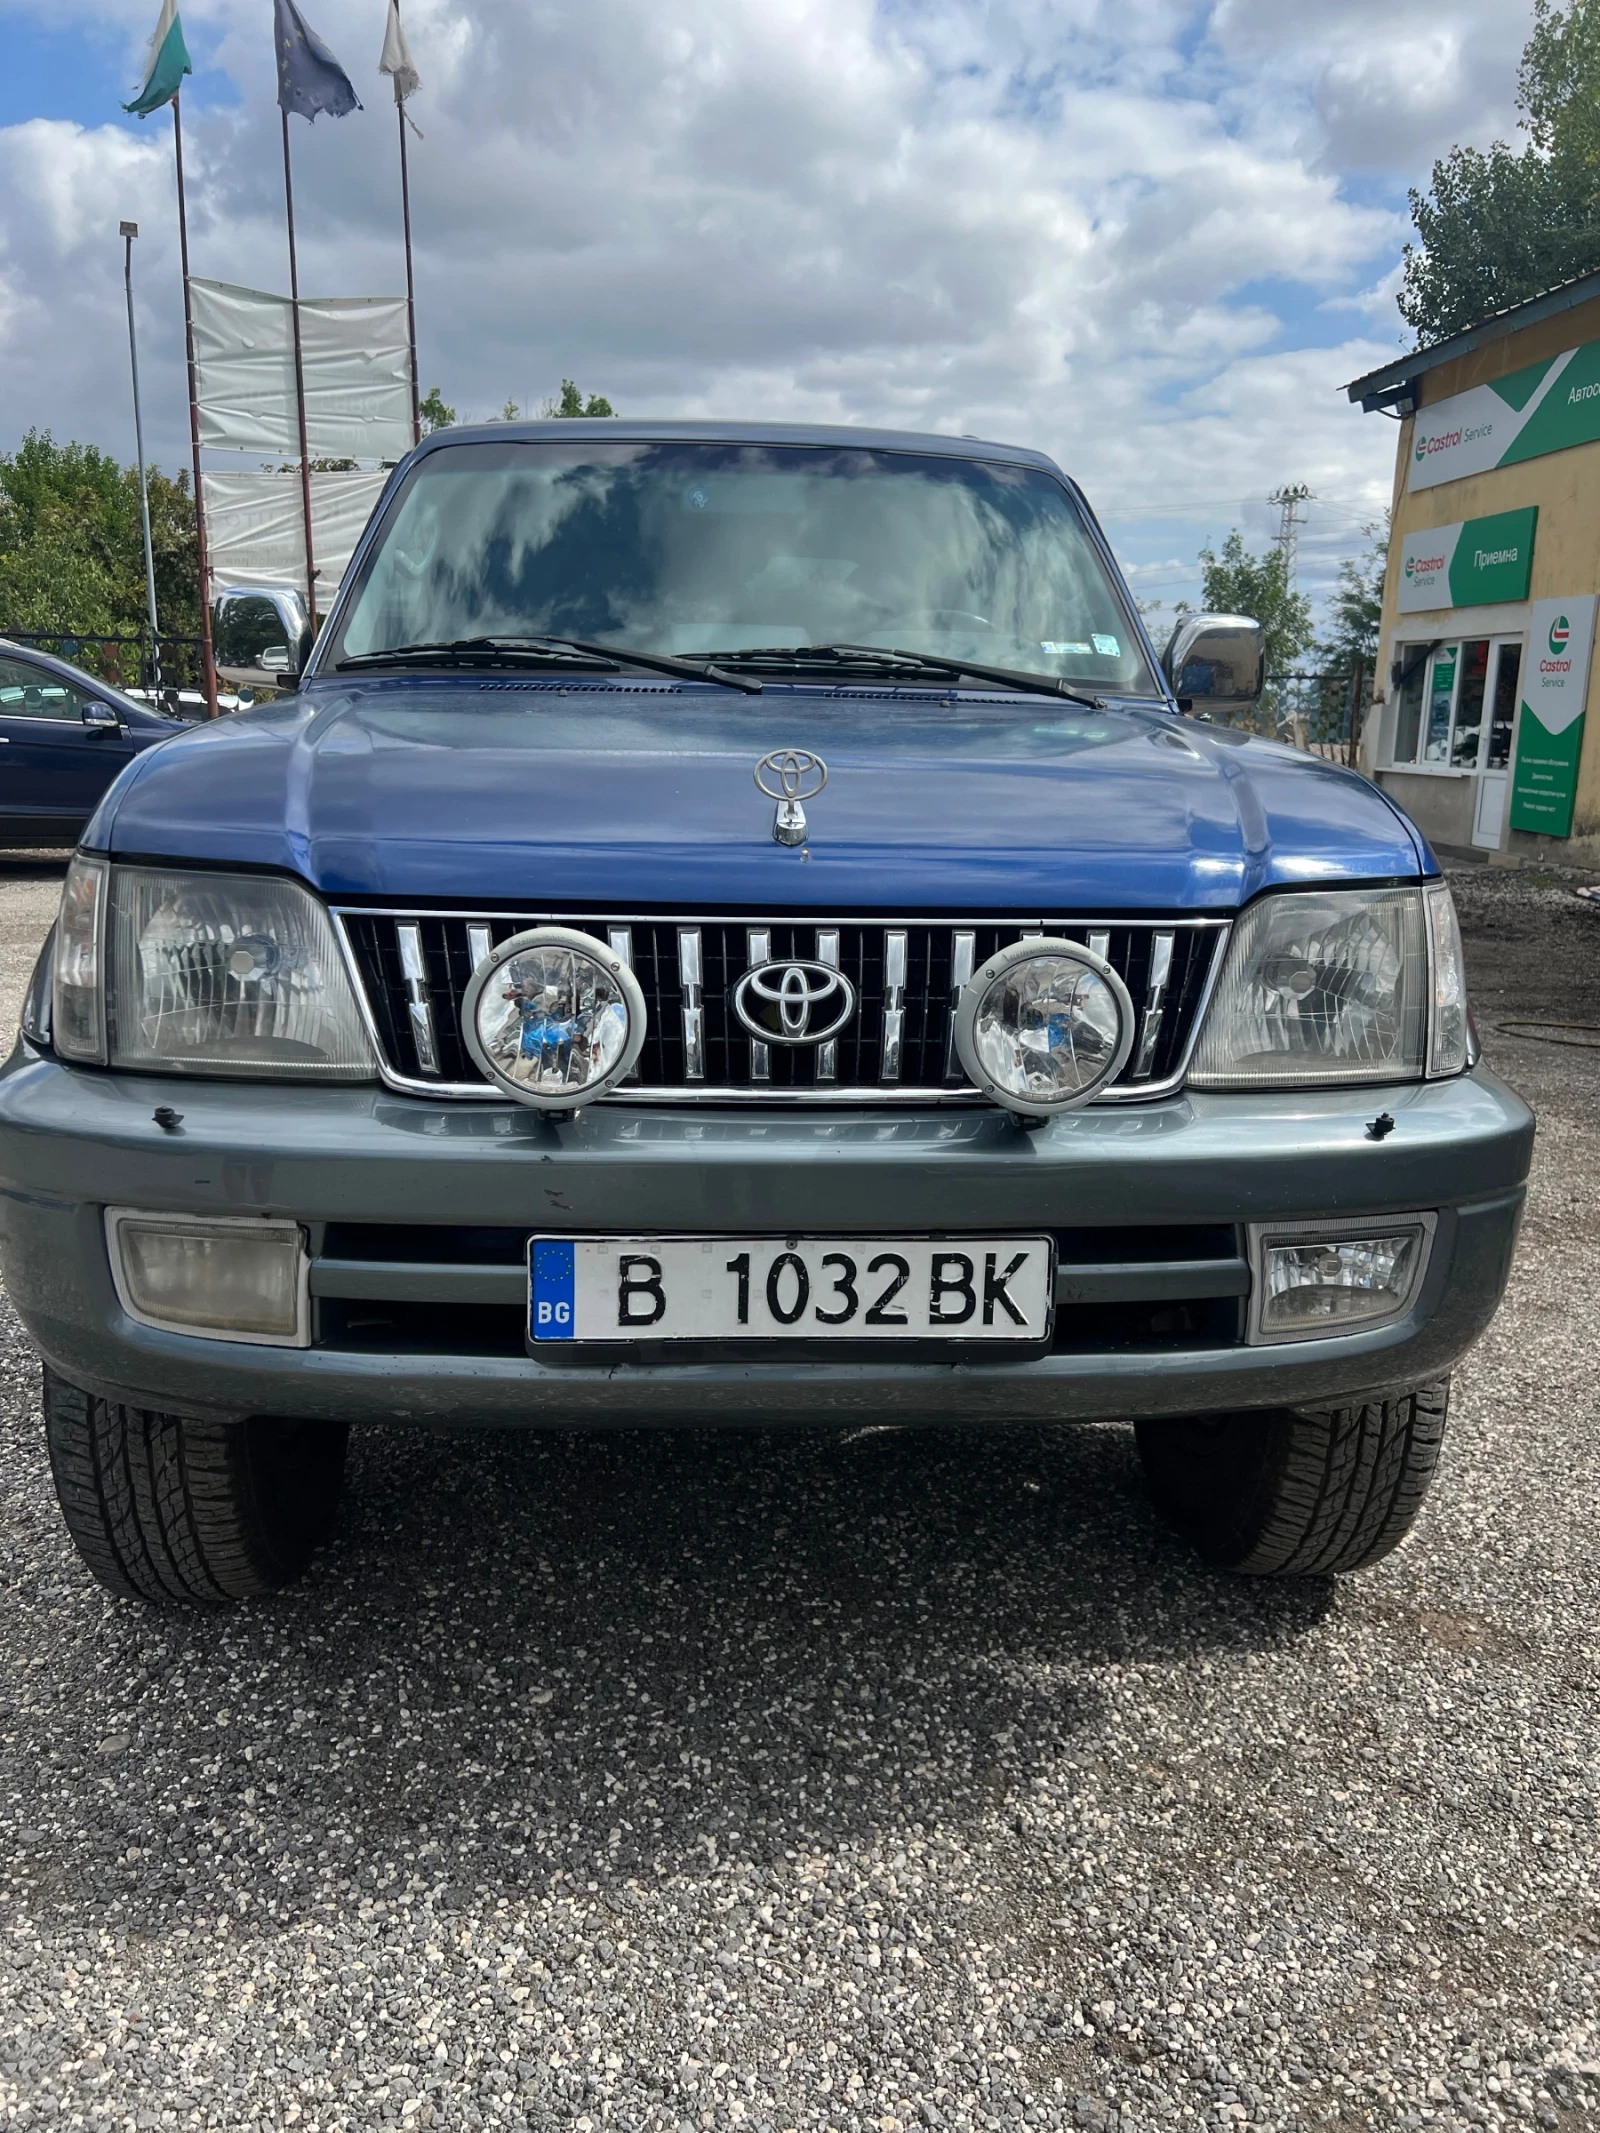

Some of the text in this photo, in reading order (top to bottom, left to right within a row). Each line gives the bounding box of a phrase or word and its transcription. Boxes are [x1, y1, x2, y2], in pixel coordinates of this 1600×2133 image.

[1567, 382, 1600, 405] Автос
[1427, 424, 1492, 454] Castrol Service
[1415, 555, 1445, 573] Castrol
[1474, 548, 1518, 571] Приемна
[1413, 575, 1435, 588] Service
[1539, 659, 1571, 673] Castrol
[1541, 677, 1565, 688] Service
[618, 1253, 1030, 1326] B 1032 BK
[537, 1302, 570, 1324] BG
